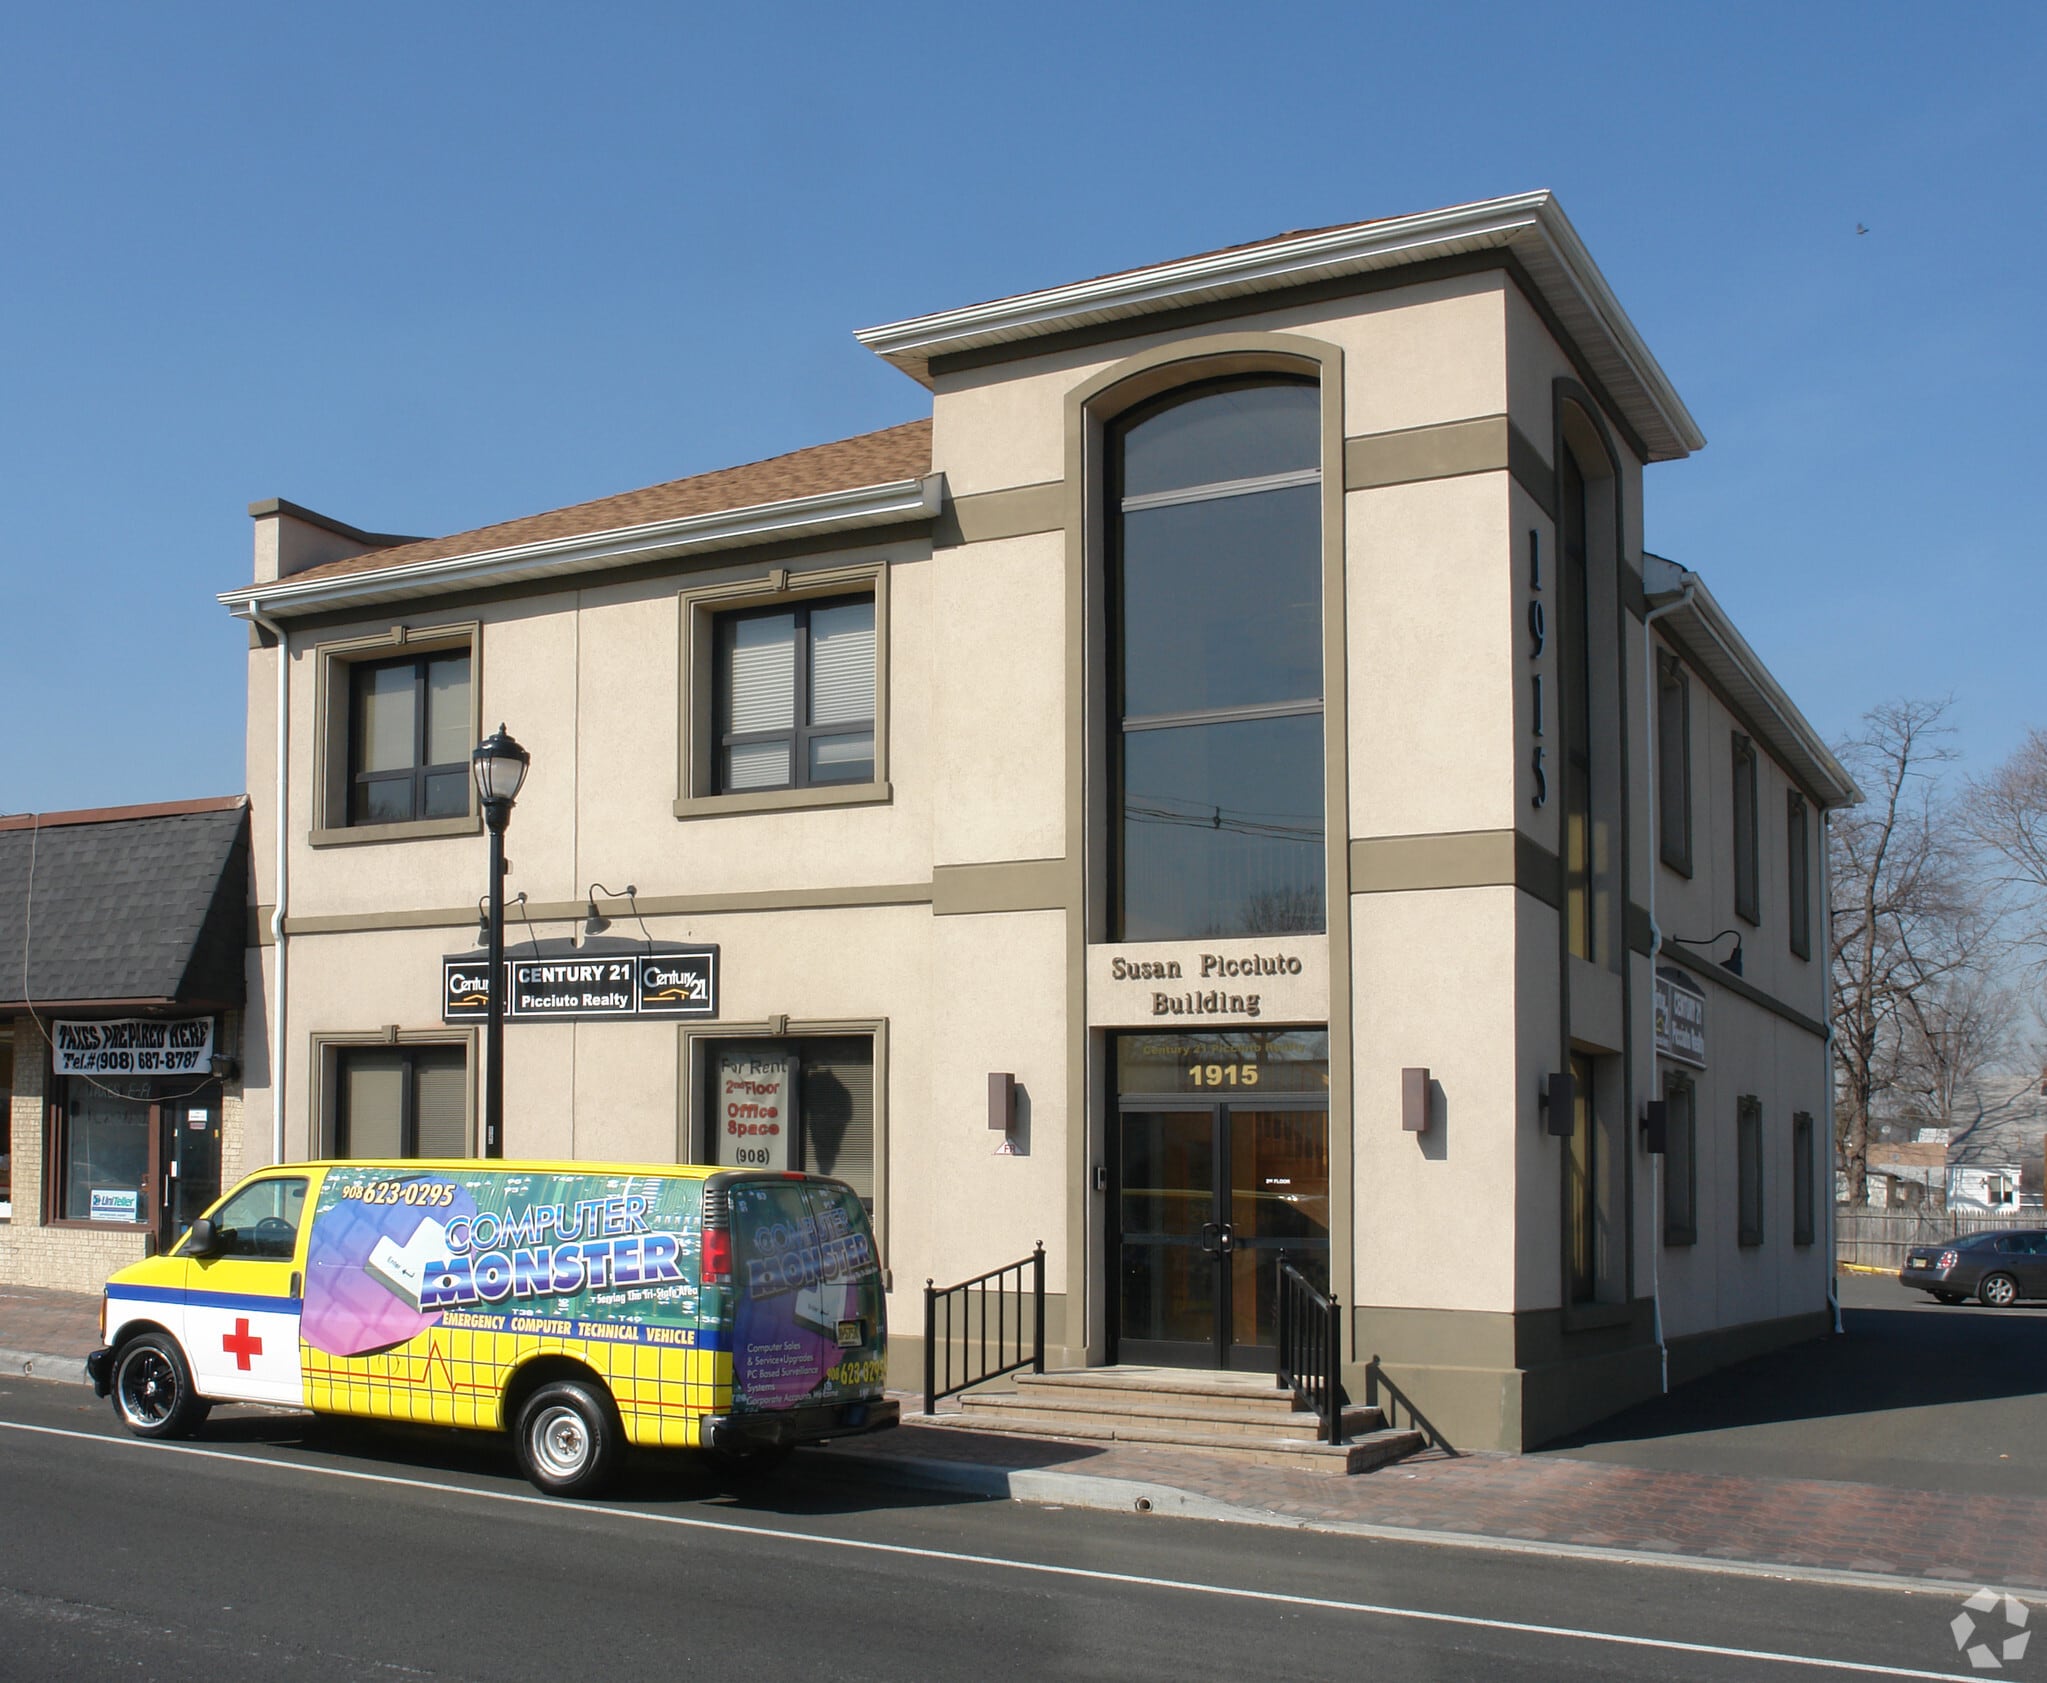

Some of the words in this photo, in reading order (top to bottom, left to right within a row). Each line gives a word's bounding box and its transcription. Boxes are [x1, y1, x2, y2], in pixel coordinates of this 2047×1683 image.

[1528, 529, 1546, 808] 1915
[519, 965, 604, 983] CENTURY
[609, 964, 629, 980] 21
[1112, 957, 1182, 980] Susan
[1199, 953, 1302, 977] Picciuto
[644, 966, 697, 988] Century
[690, 979, 707, 999] 21
[522, 994, 578, 1008] Picciuto
[582, 993, 628, 1008] Realty
[1151, 990, 1261, 1016] Building
[59, 1025, 100, 1050] TAXES
[101, 1023, 167, 1048] PREPARED
[169, 1022, 209, 1048] HERE
[1143, 1045, 1190, 1056] Century
[1193, 1044, 1206, 1053] 21
[139, 1051, 199, 1069] 687-8787
[721, 1058, 744, 1074] For
[750, 1059, 786, 1074] Rent
[1189, 1064, 1258, 1085] 1915
[745, 1081, 780, 1095] Floor
[727, 1102, 778, 1118] Office
[727, 1120, 780, 1137] Space
[736, 1147, 770, 1165] (908)
[102, 1196, 134, 1206] UniTeller
[342, 1186, 363, 1199] 908
[363, 1182, 456, 1207] 623-0295
[445, 1195, 650, 1252] COMPUTER
[755, 1208, 850, 1256] COMPUTER
[419, 1234, 688, 1307] MONSTER
[747, 1233, 872, 1299] MONSTER
[442, 1311, 505, 1330] EMERGENCY
[511, 1317, 572, 1335] COMPUTER
[578, 1322, 639, 1340] TECHNICAL
[646, 1327, 695, 1344] VEHICLE
[747, 1343, 782, 1355] Computer
[784, 1341, 800, 1351] Sales
[747, 1369, 757, 1379] PC
[759, 1368, 779, 1378] Based
[747, 1383, 775, 1393] Systems
